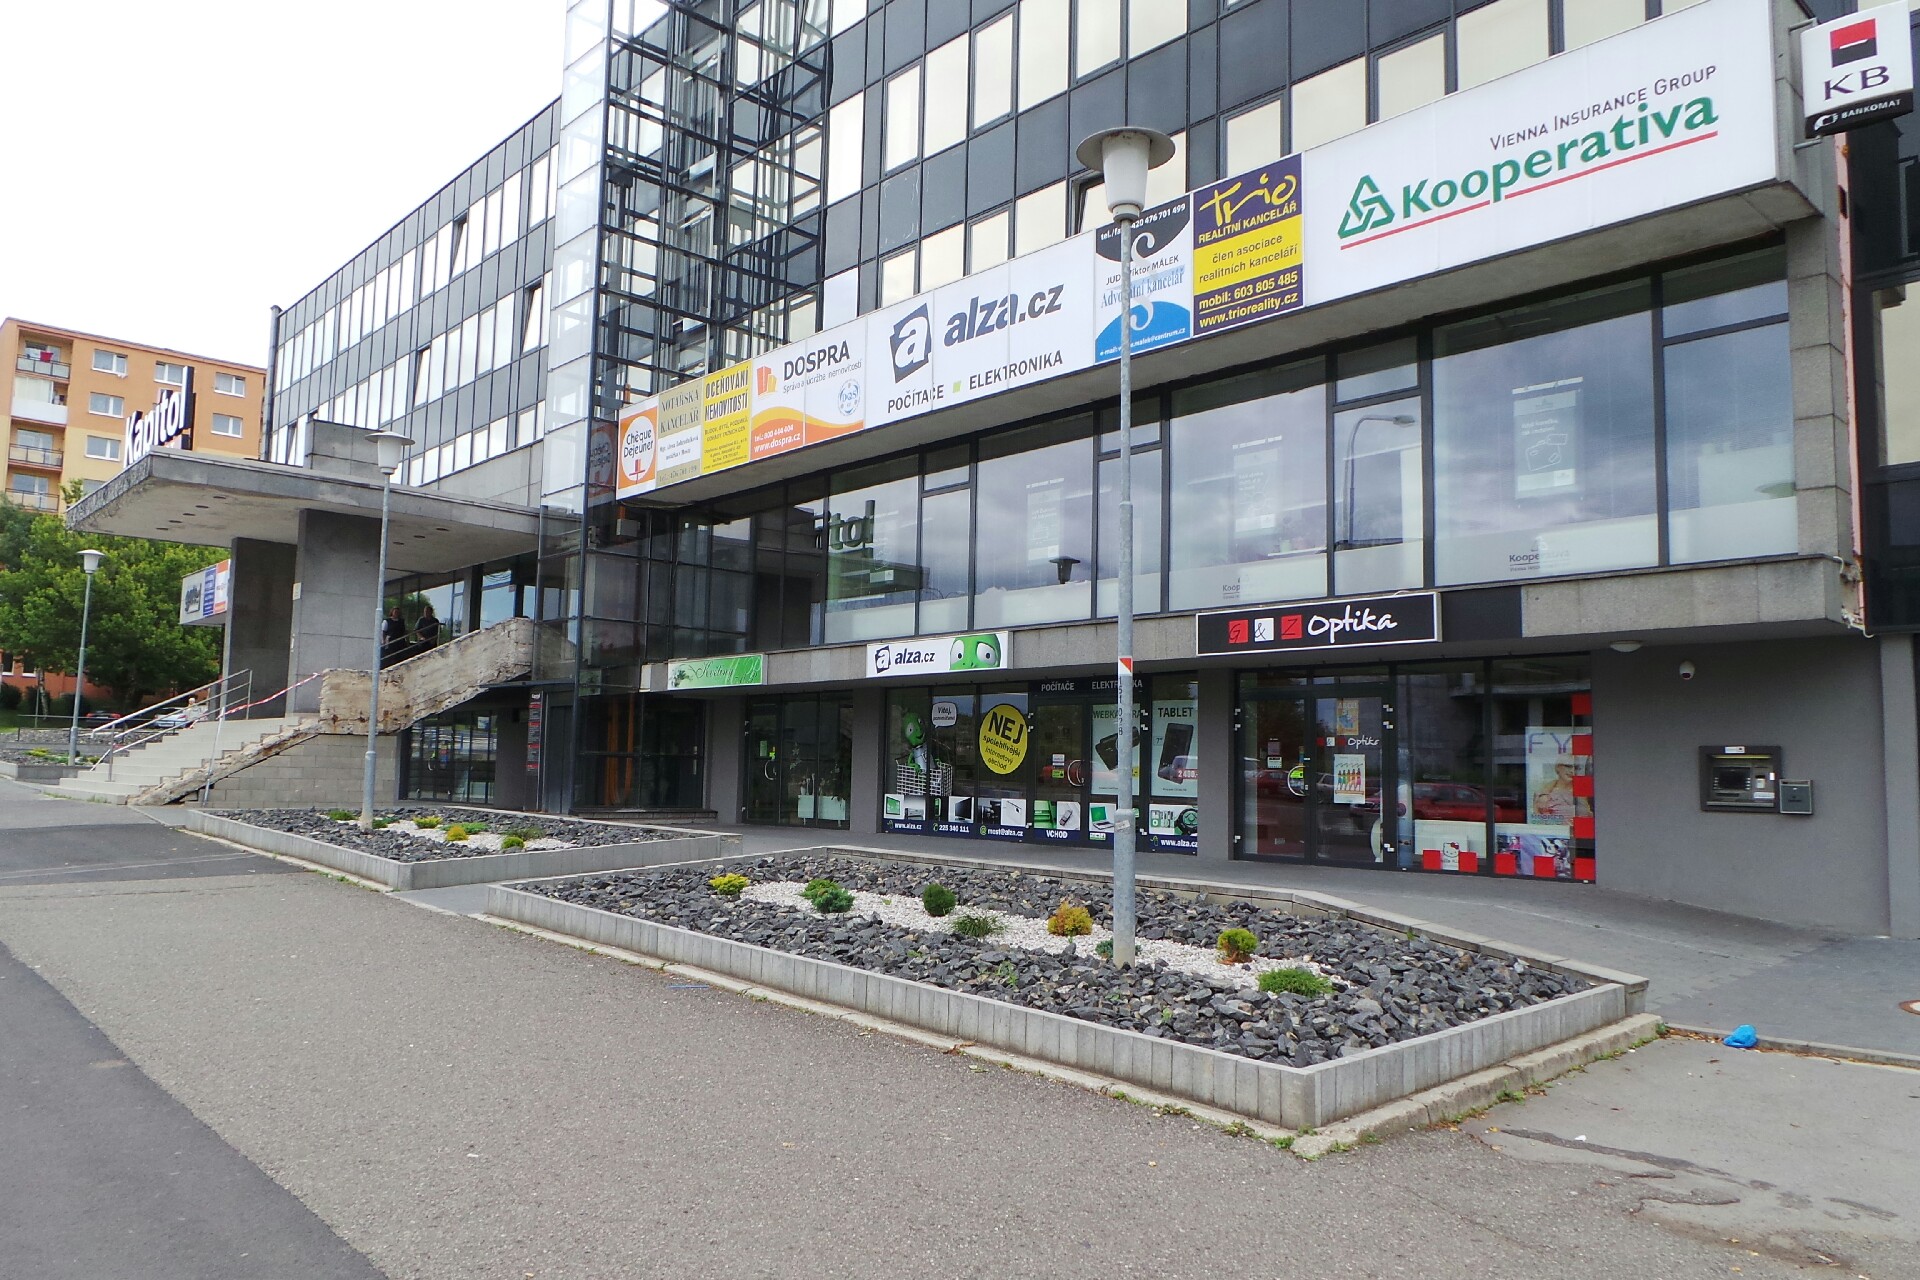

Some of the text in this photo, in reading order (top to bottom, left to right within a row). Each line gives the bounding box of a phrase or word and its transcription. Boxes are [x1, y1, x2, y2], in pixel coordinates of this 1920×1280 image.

[1824, 65, 1890, 100] KB
[1553, 88, 1646, 133] INSURANCE
[1654, 65, 1717, 97] GROUP
[1841, 98, 1902, 119] BANKOMAT
[1403, 95, 1718, 218] Kooperativa
[1144, 214, 1158, 224] 476
[1158, 208, 1171, 219] 701
[1172, 203, 1186, 214] 499
[1199, 172, 1297, 227] Trio
[1198, 203, 1297, 245] REALITNÍ KANCELÁŘ
[1151, 254, 1179, 271] MÁLEK
[1212, 235, 1283, 264] člen asociace
[1199, 246, 1298, 283] realitních kanceláří
[1147, 267, 1185, 294] kancelář
[1199, 271, 1298, 310] mobil: 603 805 485
[944, 283, 1064, 347] alza.cz
[1199, 292, 1298, 330] www.trioreality.cz
[783, 340, 850, 381] DOSPRA
[705, 366, 749, 399] OCEŇOVÁNÍ
[124, 366, 193, 469] Kapitol
[705, 388, 749, 421] NEMOVITOSTÍ
[623, 441, 654, 460] Dejeuner
[626, 428, 652, 446] Chèque
[754, 432, 801, 453] www.dospra.cz
[1308, 605, 1398, 644] Optika
[894, 647, 935, 666] alza.cz
[1041, 680, 1075, 692] POČÍTAČE
[1157, 707, 1194, 718] TABLET
[988, 711, 1025, 745] NEJ
[983, 735, 1021, 758] spolehlivější
[985, 746, 1014, 765] internetový
[987, 757, 1007, 771] obchod
[1045, 830, 1068, 839] VCHOD
[1160, 838, 1198, 848] www.alza.cz
